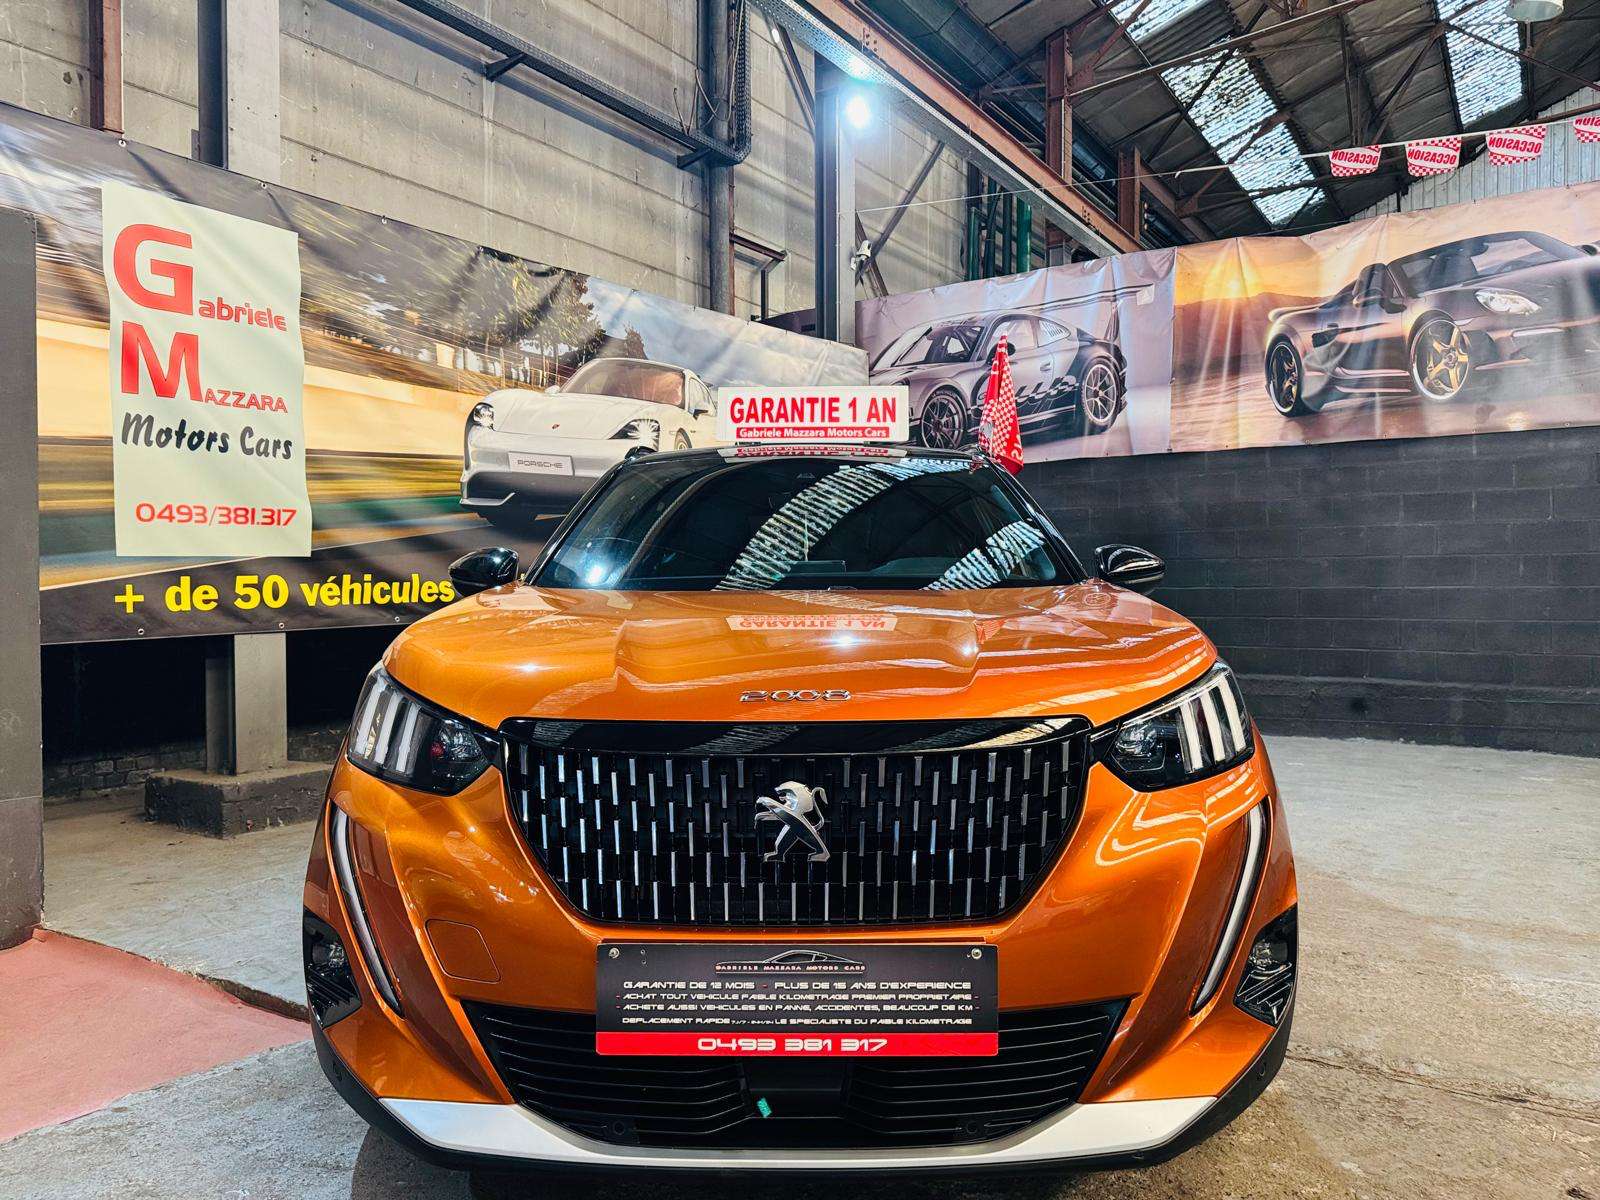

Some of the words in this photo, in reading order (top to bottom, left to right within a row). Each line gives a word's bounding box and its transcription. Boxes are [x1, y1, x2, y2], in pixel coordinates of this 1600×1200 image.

[730, 396, 840, 424] GARANTIE
[848, 397, 857, 423] 1
[866, 397, 897, 423] AN
[121, 412, 230, 453] Motors
[239, 426, 293, 460] Cars
[739, 427, 782, 438] Gabriele
[783, 427, 825, 438] Mazzara
[827, 427, 863, 438] Motors
[864, 427, 887, 438] Cars
[517, 459, 563, 469] PORSCHE
[135, 502, 297, 527] 0493/381.317
[164, 575, 219, 612] de
[233, 574, 290, 610] 50
[300, 573, 456, 607] véhicules
[739, 689, 852, 702] 2008
[623, 981, 686, 990] GARANTIE
[689, 981, 707, 990] DE
[710, 981, 722, 990] 12
[725, 981, 755, 990] MOIS
[775, 982, 809, 990] PLUS
[812, 982, 830, 990] DE
[833, 982, 847, 990] 15
[850, 982, 877, 990] ANS
[880, 982, 972, 990] D'EXPERIENCE
[697, 1038, 776, 1051] 0493
[784, 1038, 833, 1051] 381
[840, 1038, 888, 1051] 317
